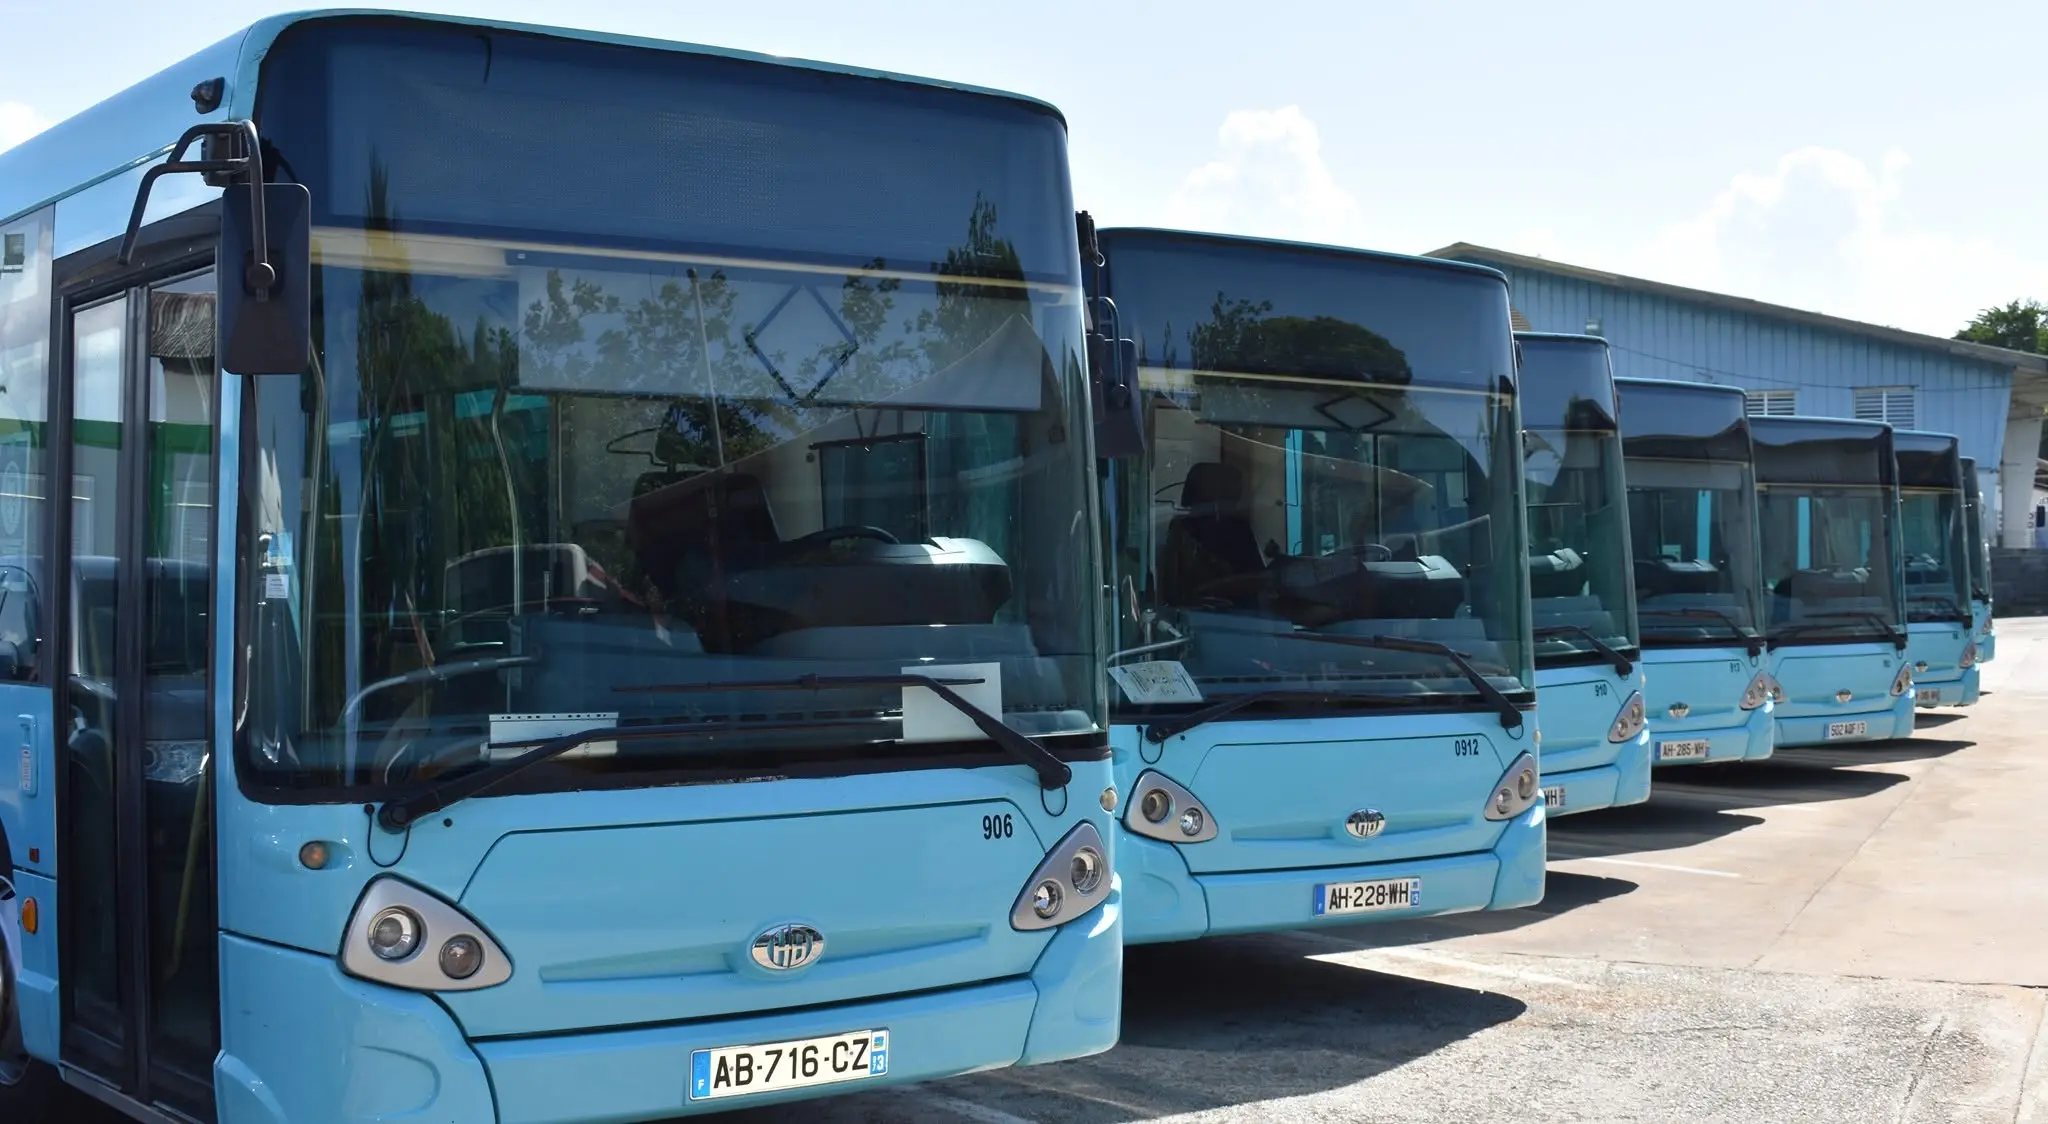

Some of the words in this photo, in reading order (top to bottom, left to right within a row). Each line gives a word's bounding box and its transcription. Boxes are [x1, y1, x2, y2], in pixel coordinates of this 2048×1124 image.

[1595, 683, 1607, 697] 910
[1455, 739, 1479, 756] 0912
[983, 814, 1013, 840] 906
[1329, 882, 1409, 910] AH-228-WH
[713, 1037, 869, 1089] AB-716-CZ
